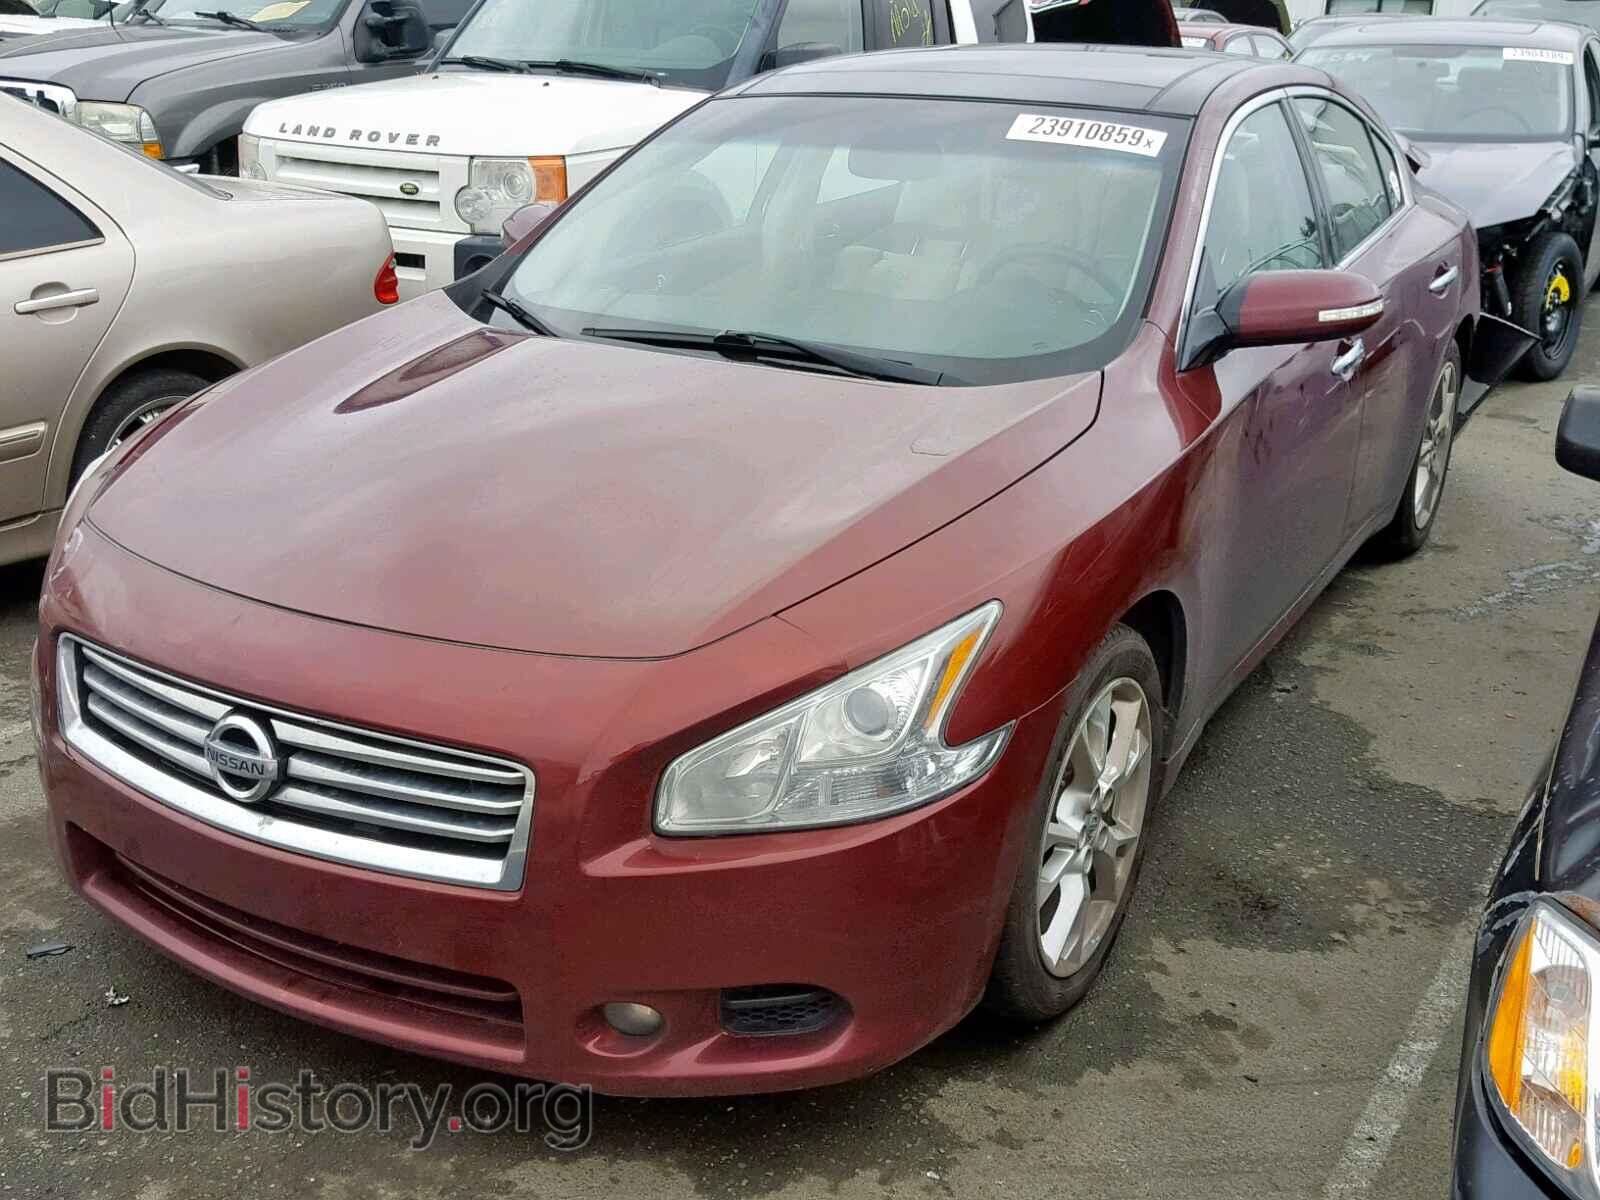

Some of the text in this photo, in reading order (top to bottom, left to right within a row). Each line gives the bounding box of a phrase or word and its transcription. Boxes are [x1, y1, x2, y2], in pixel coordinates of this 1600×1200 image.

[279, 122, 441, 147] LAND ROVER
[207, 747, 265, 776] NISSAN
